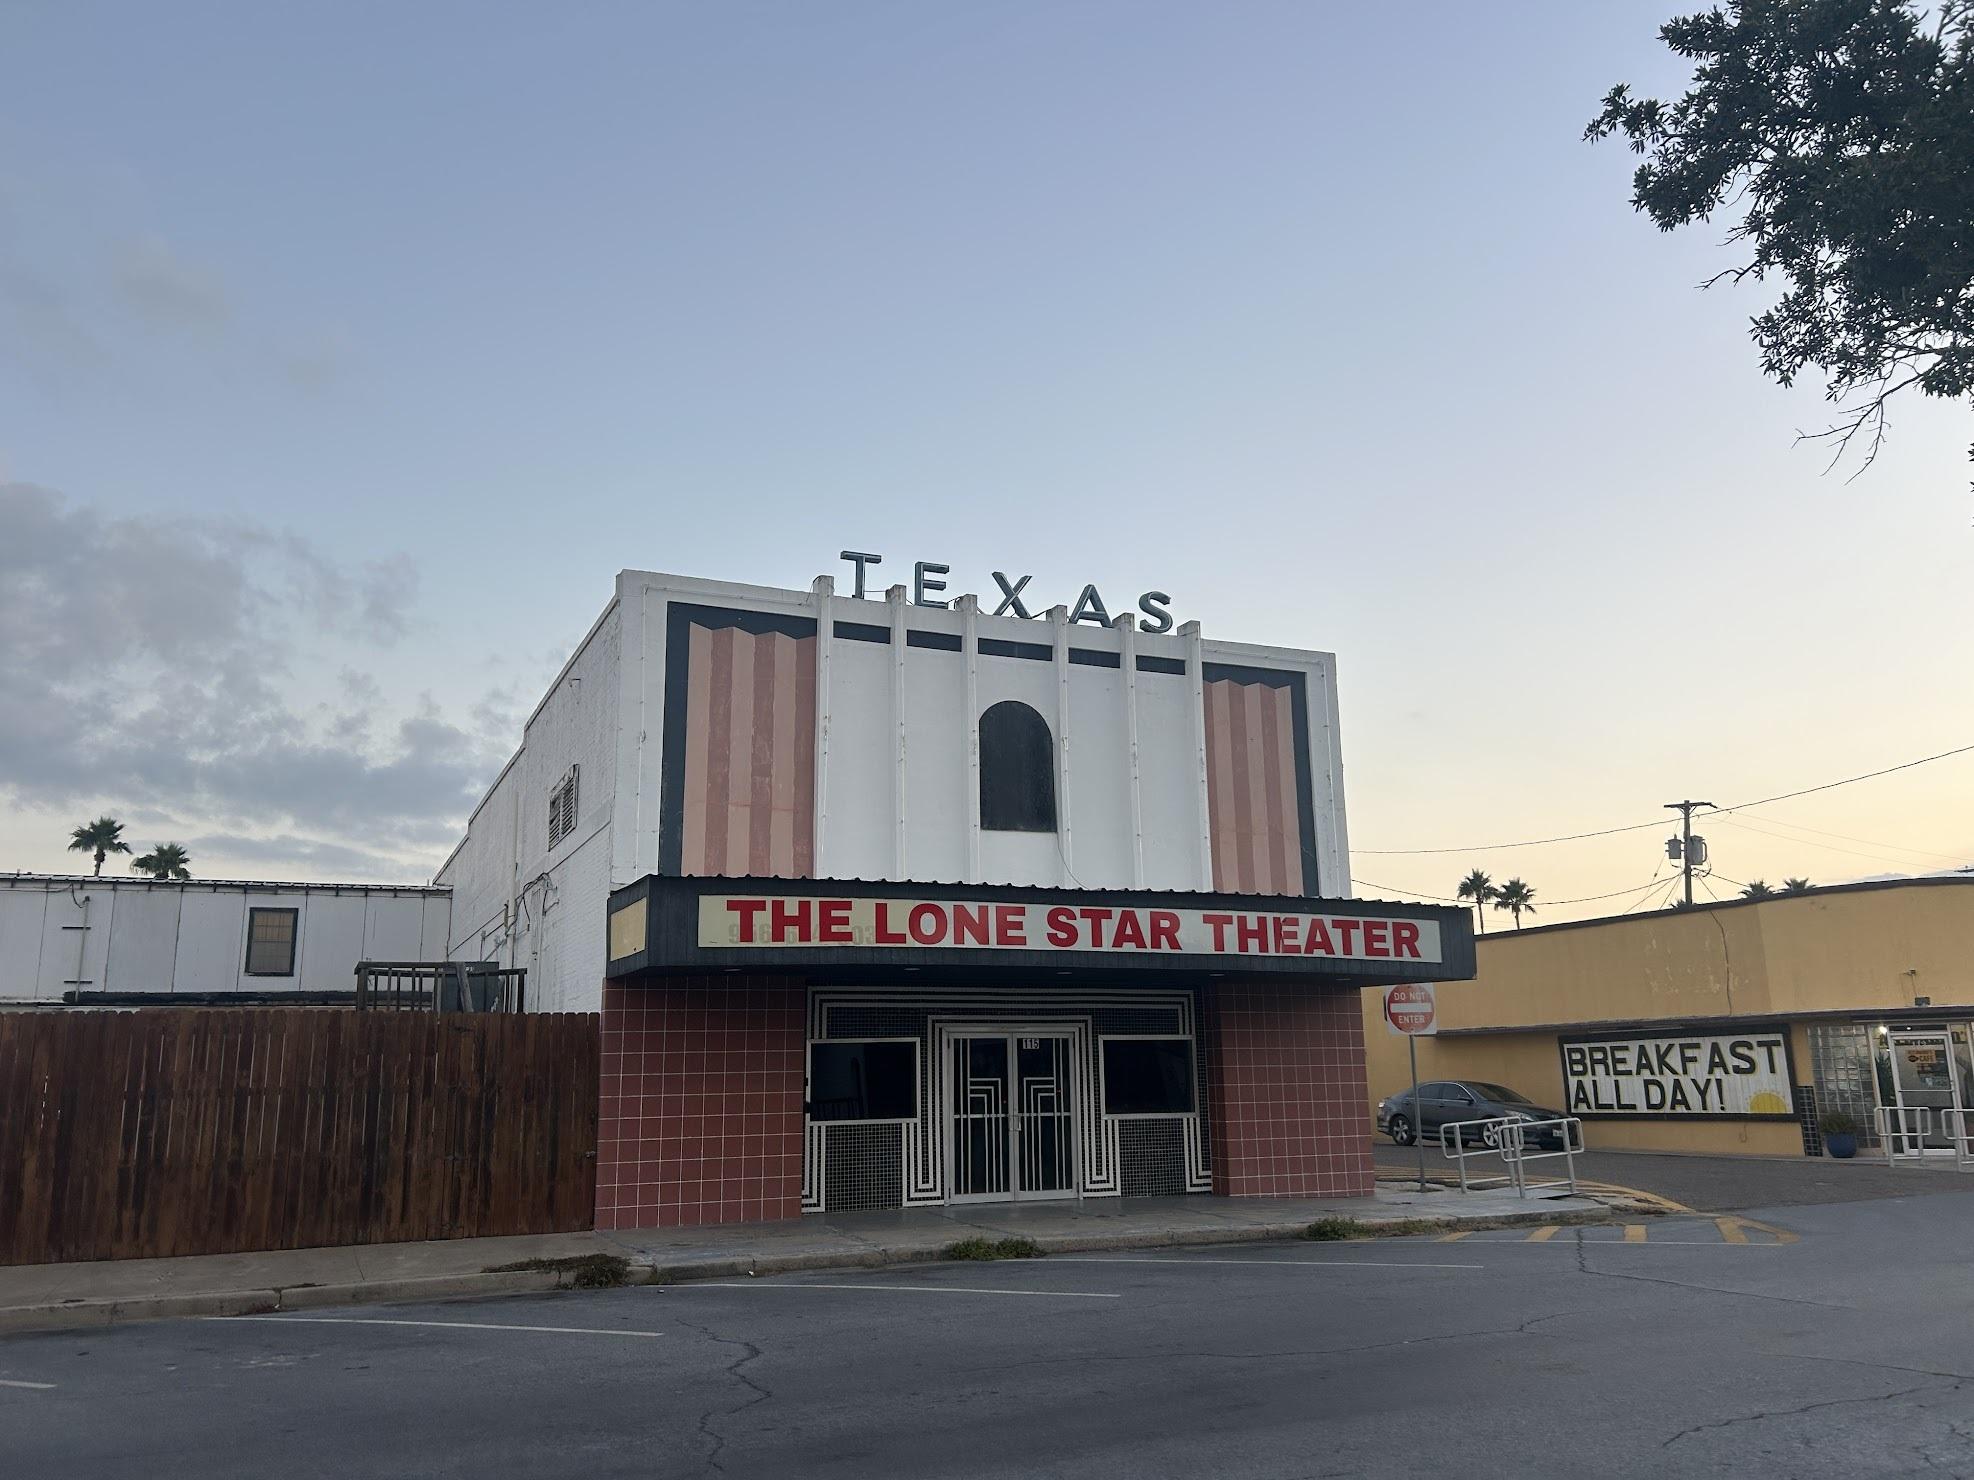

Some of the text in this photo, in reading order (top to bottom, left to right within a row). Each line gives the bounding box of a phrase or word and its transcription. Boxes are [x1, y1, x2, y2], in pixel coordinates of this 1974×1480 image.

[840, 550, 1173, 634] TEXAS
[728, 899, 853, 942] THE
[876, 904, 1025, 948] LONE
[1047, 907, 1180, 951] STAR
[1203, 914, 1421, 958] THEATER
[1394, 991, 1425, 1001] DO NOT
[1398, 1015, 1425, 1024] ENTER
[1566, 1040, 1782, 1078] BREAKFAST
[1574, 1078, 1726, 1112] ALL DAY!
